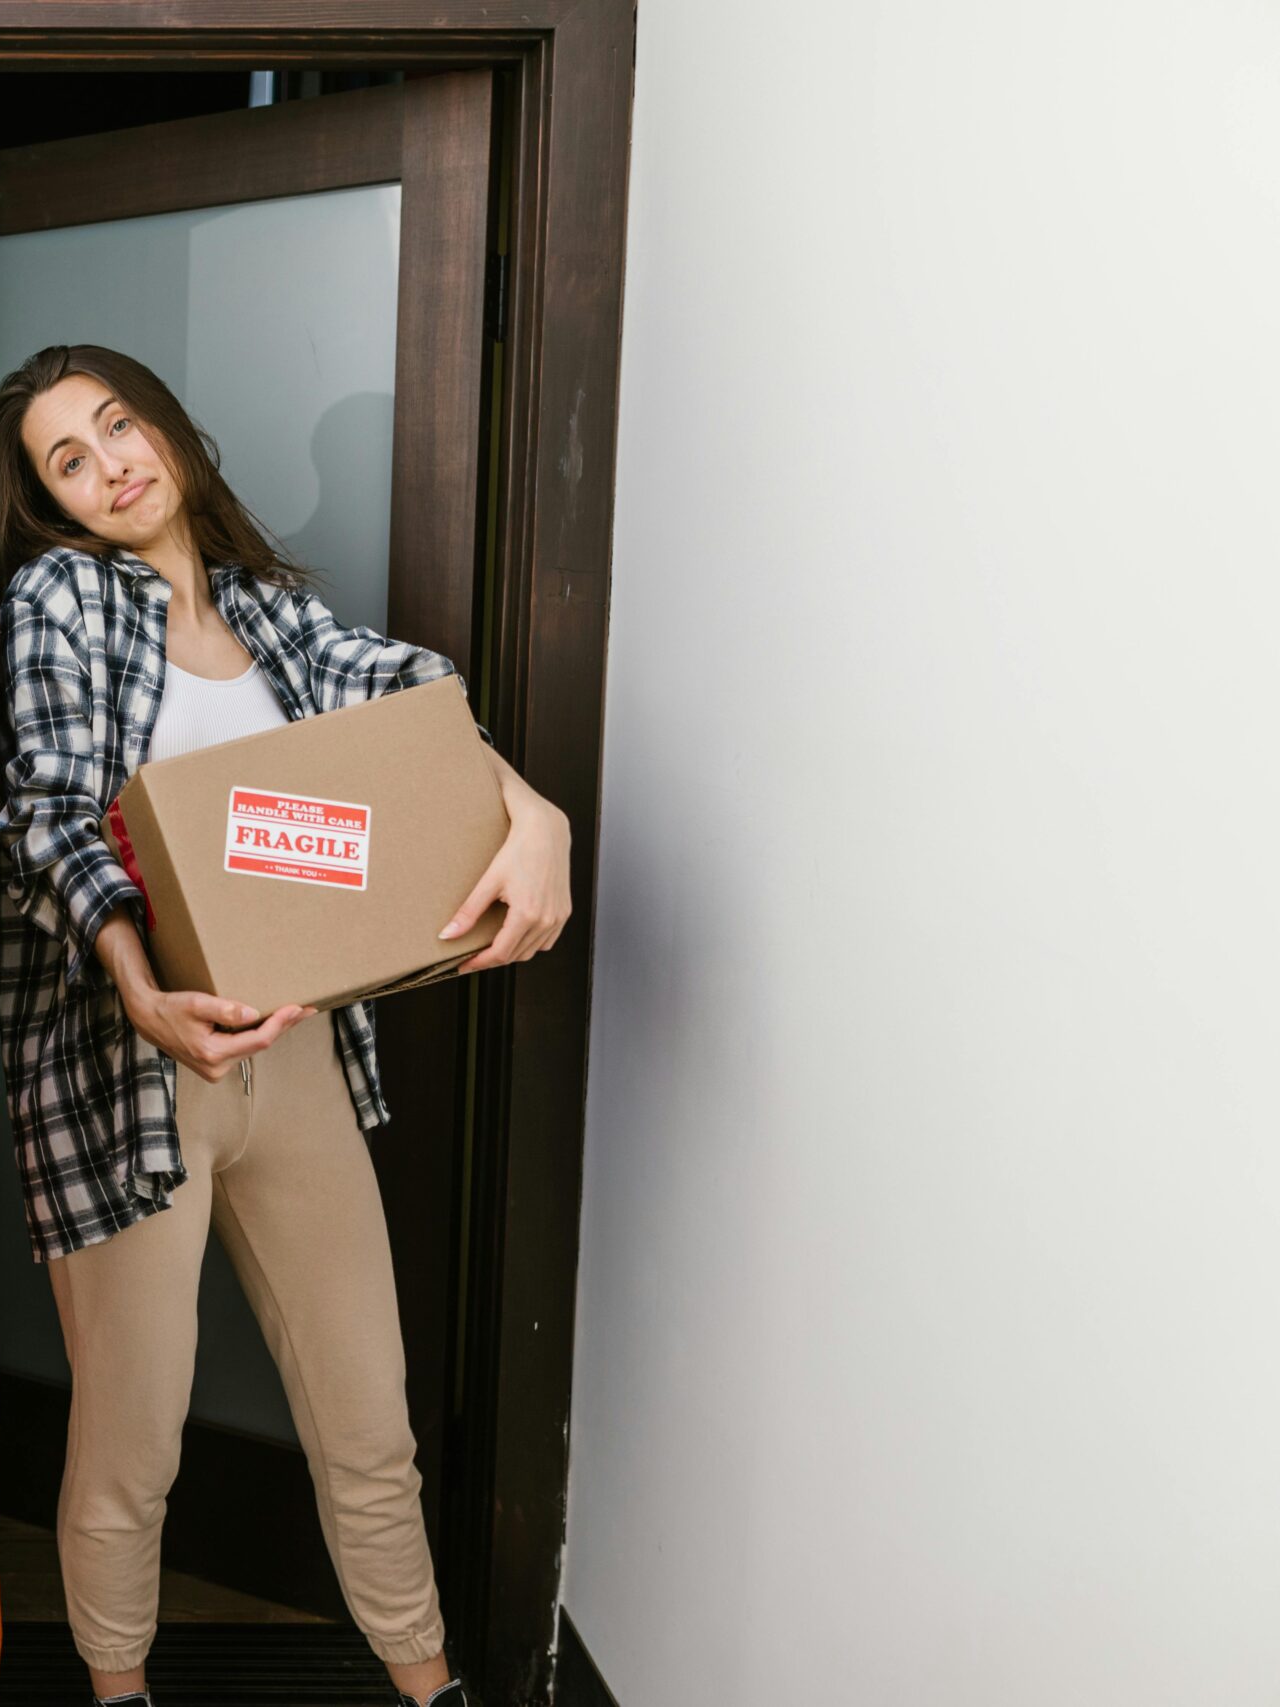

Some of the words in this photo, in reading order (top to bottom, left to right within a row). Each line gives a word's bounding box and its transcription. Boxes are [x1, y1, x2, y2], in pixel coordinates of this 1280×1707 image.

[237, 803, 289, 818] HANDLE
[292, 811, 326, 824] WITH
[327, 817, 363, 830] CARE
[277, 800, 325, 815] PLEASE
[235, 825, 360, 861] FRAGILE
[274, 865, 300, 876] THANK
[301, 868, 318, 878] YOU
